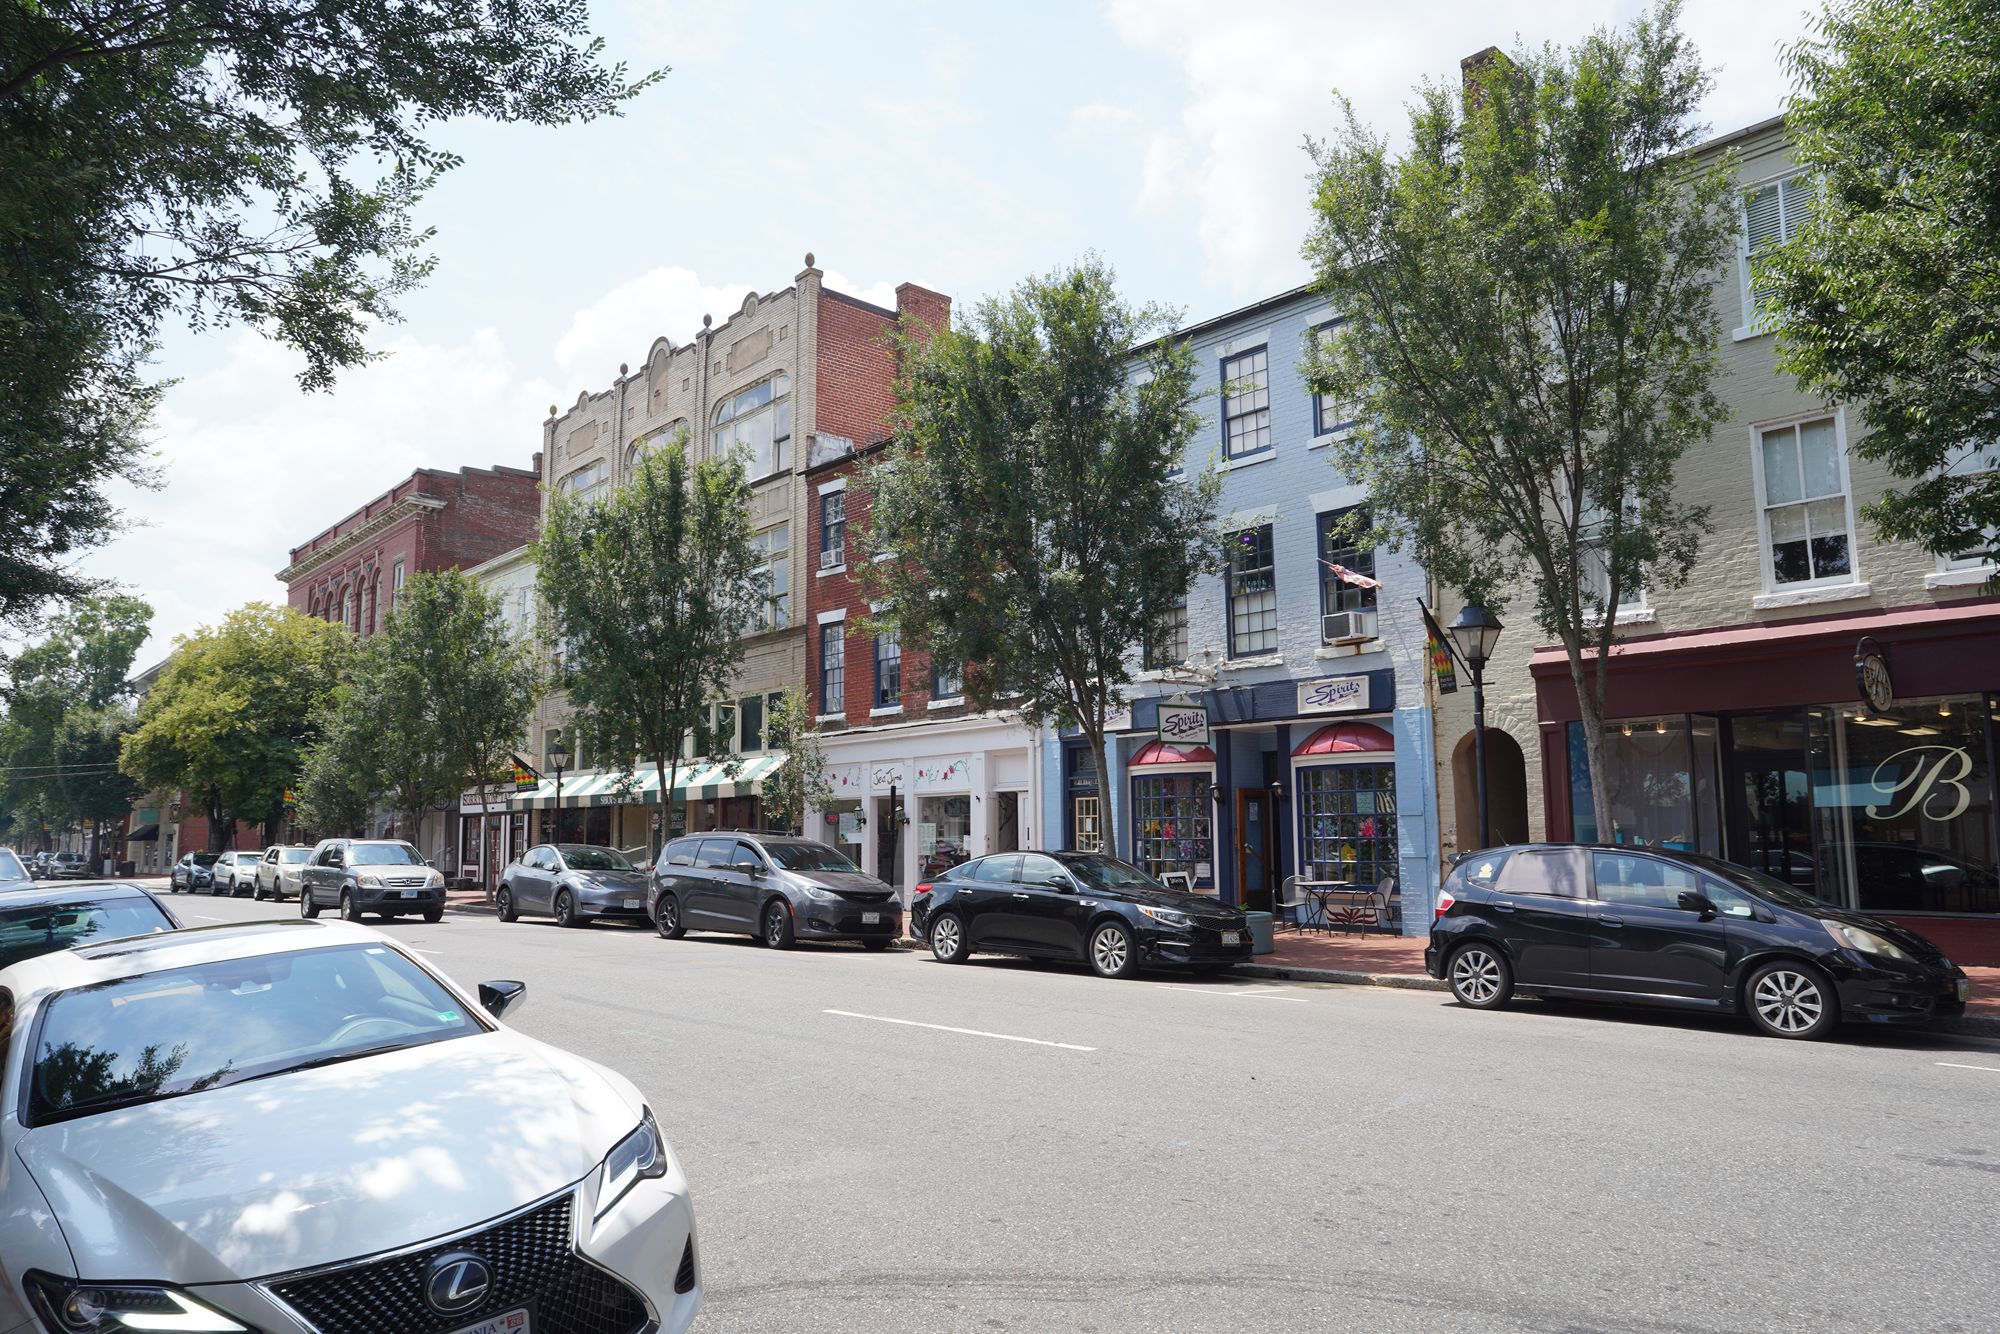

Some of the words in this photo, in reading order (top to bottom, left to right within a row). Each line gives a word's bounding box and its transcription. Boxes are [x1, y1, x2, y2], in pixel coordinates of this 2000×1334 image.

[1306, 681, 1360, 704] Spirits
[1162, 711, 1205, 733] Spirits
[1865, 745, 1973, 821] B
